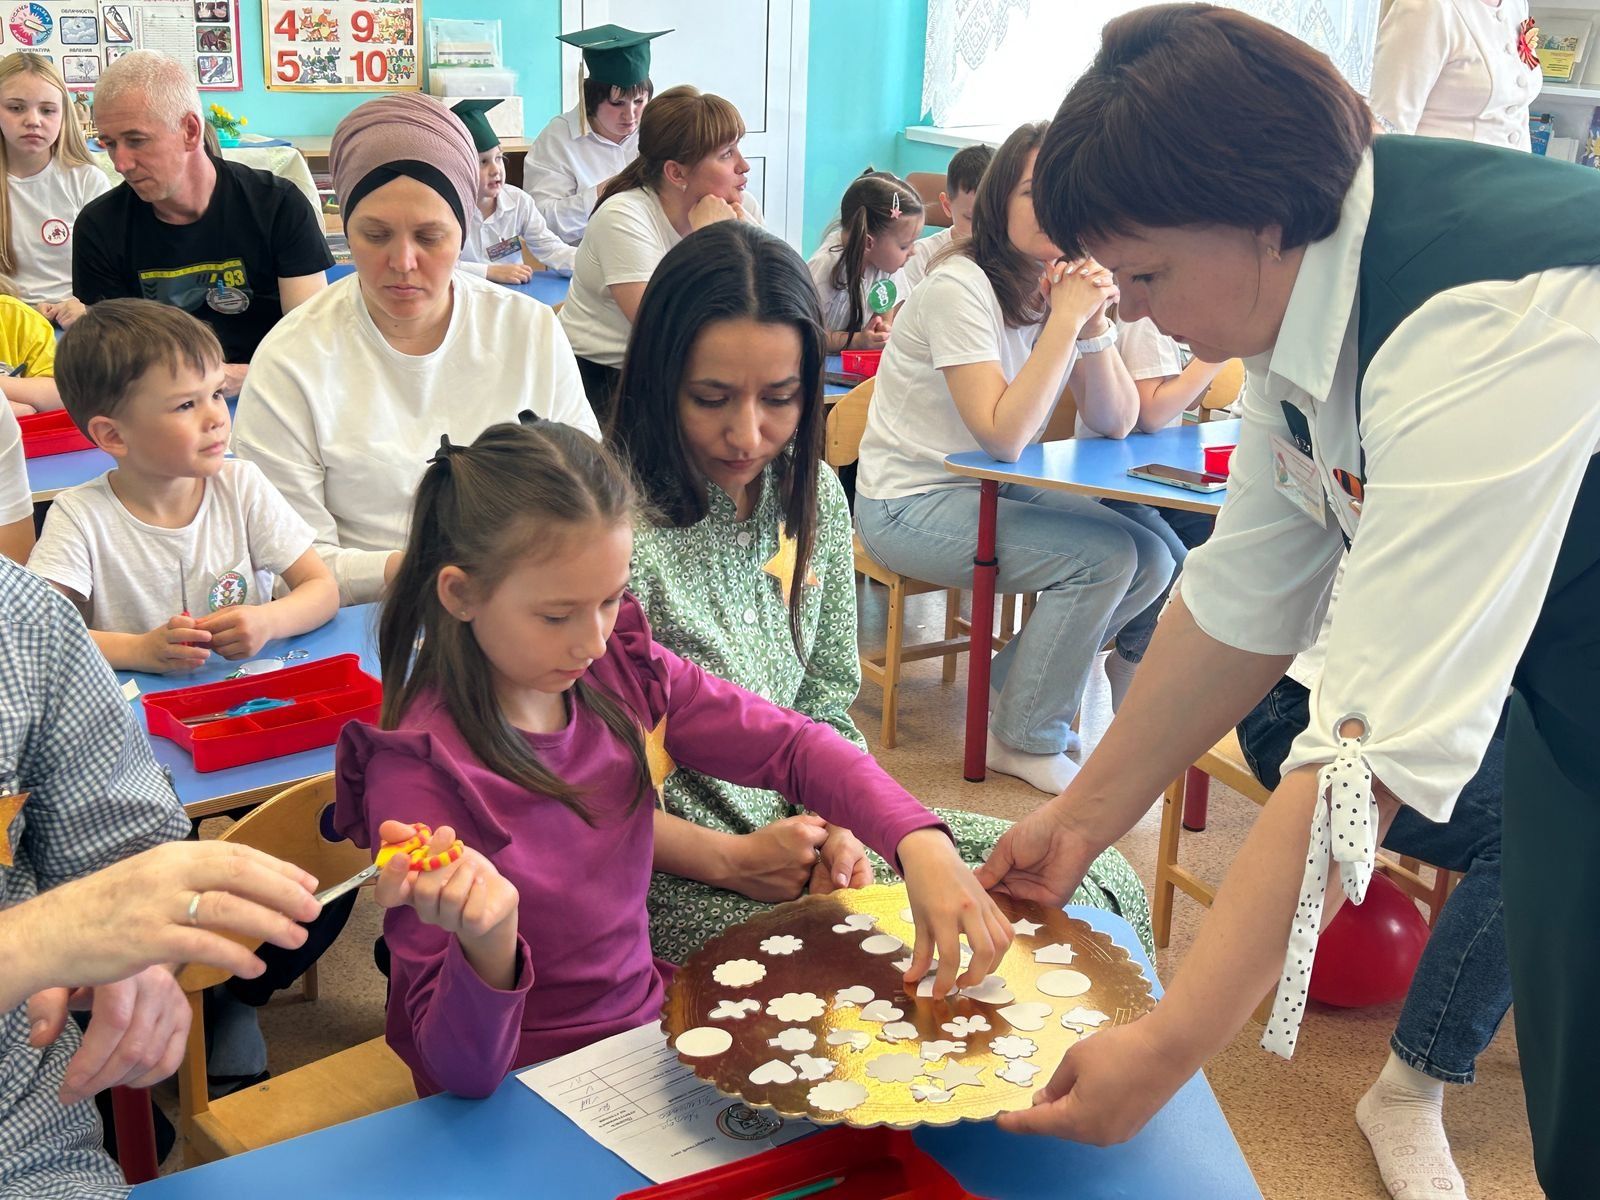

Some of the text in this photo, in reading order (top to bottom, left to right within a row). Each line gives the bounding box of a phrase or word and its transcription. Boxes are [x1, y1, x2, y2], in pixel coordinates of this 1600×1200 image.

[274, 10, 299, 42] 4
[350, 10, 374, 43] 9
[276, 51, 300, 82] 5
[350, 51, 388, 82] 10
[224, 270, 246, 288] 93
